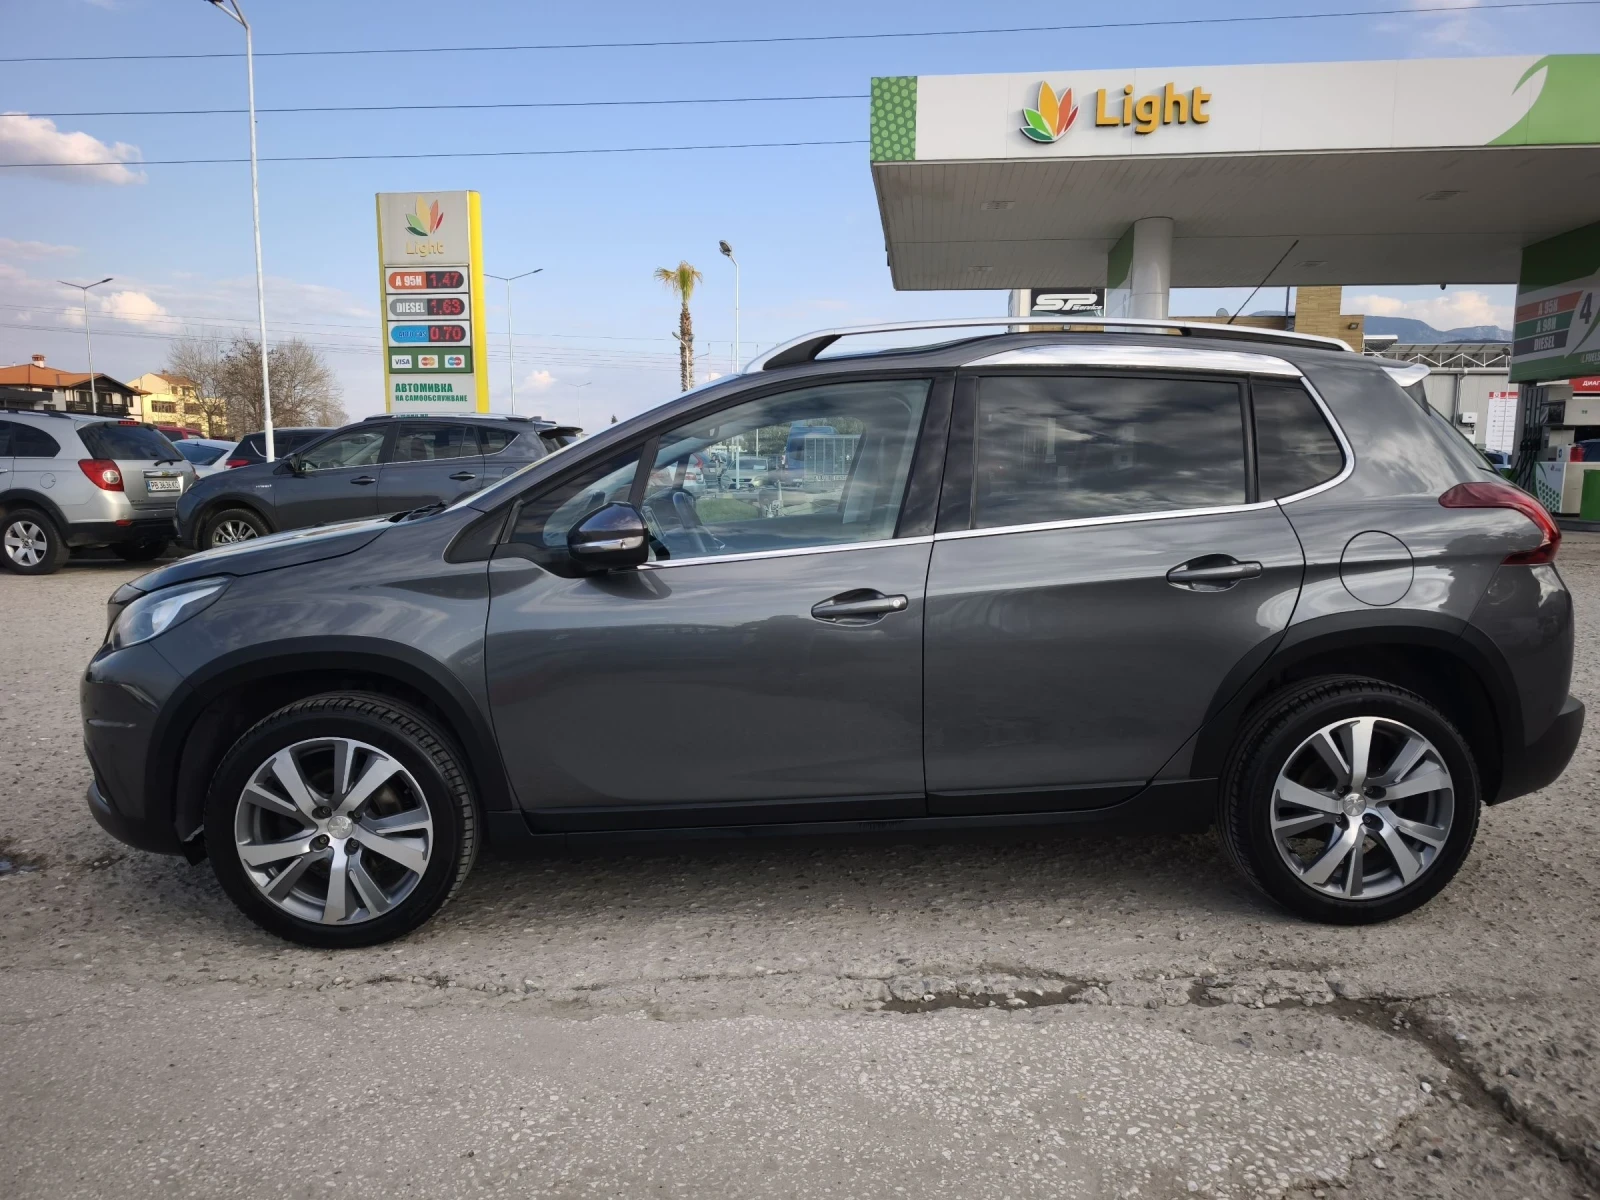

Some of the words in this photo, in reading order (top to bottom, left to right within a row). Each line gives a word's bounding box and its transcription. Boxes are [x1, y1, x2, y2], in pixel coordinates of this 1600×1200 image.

[1095, 82, 1212, 135] Light
[406, 240, 444, 257] Light
[395, 275, 402, 287] A
[403, 275, 422, 287] 95H
[429, 272, 460, 287] 1.47
[396, 302, 425, 313] DIESEL
[430, 299, 461, 314] 1.63
[1031, 293, 1098, 311] SP
[1538, 303, 1543, 315] A
[1580, 292, 1592, 324] 4
[429, 326, 463, 340] 0.70
[1536, 320, 1541, 333] A
[1534, 335, 1554, 350] DIESEL
[395, 383, 453, 392] АВТОМИВКА
[395, 394, 405, 402] НА
[405, 394, 467, 402] САМООБСЛУЖВАНЕ
